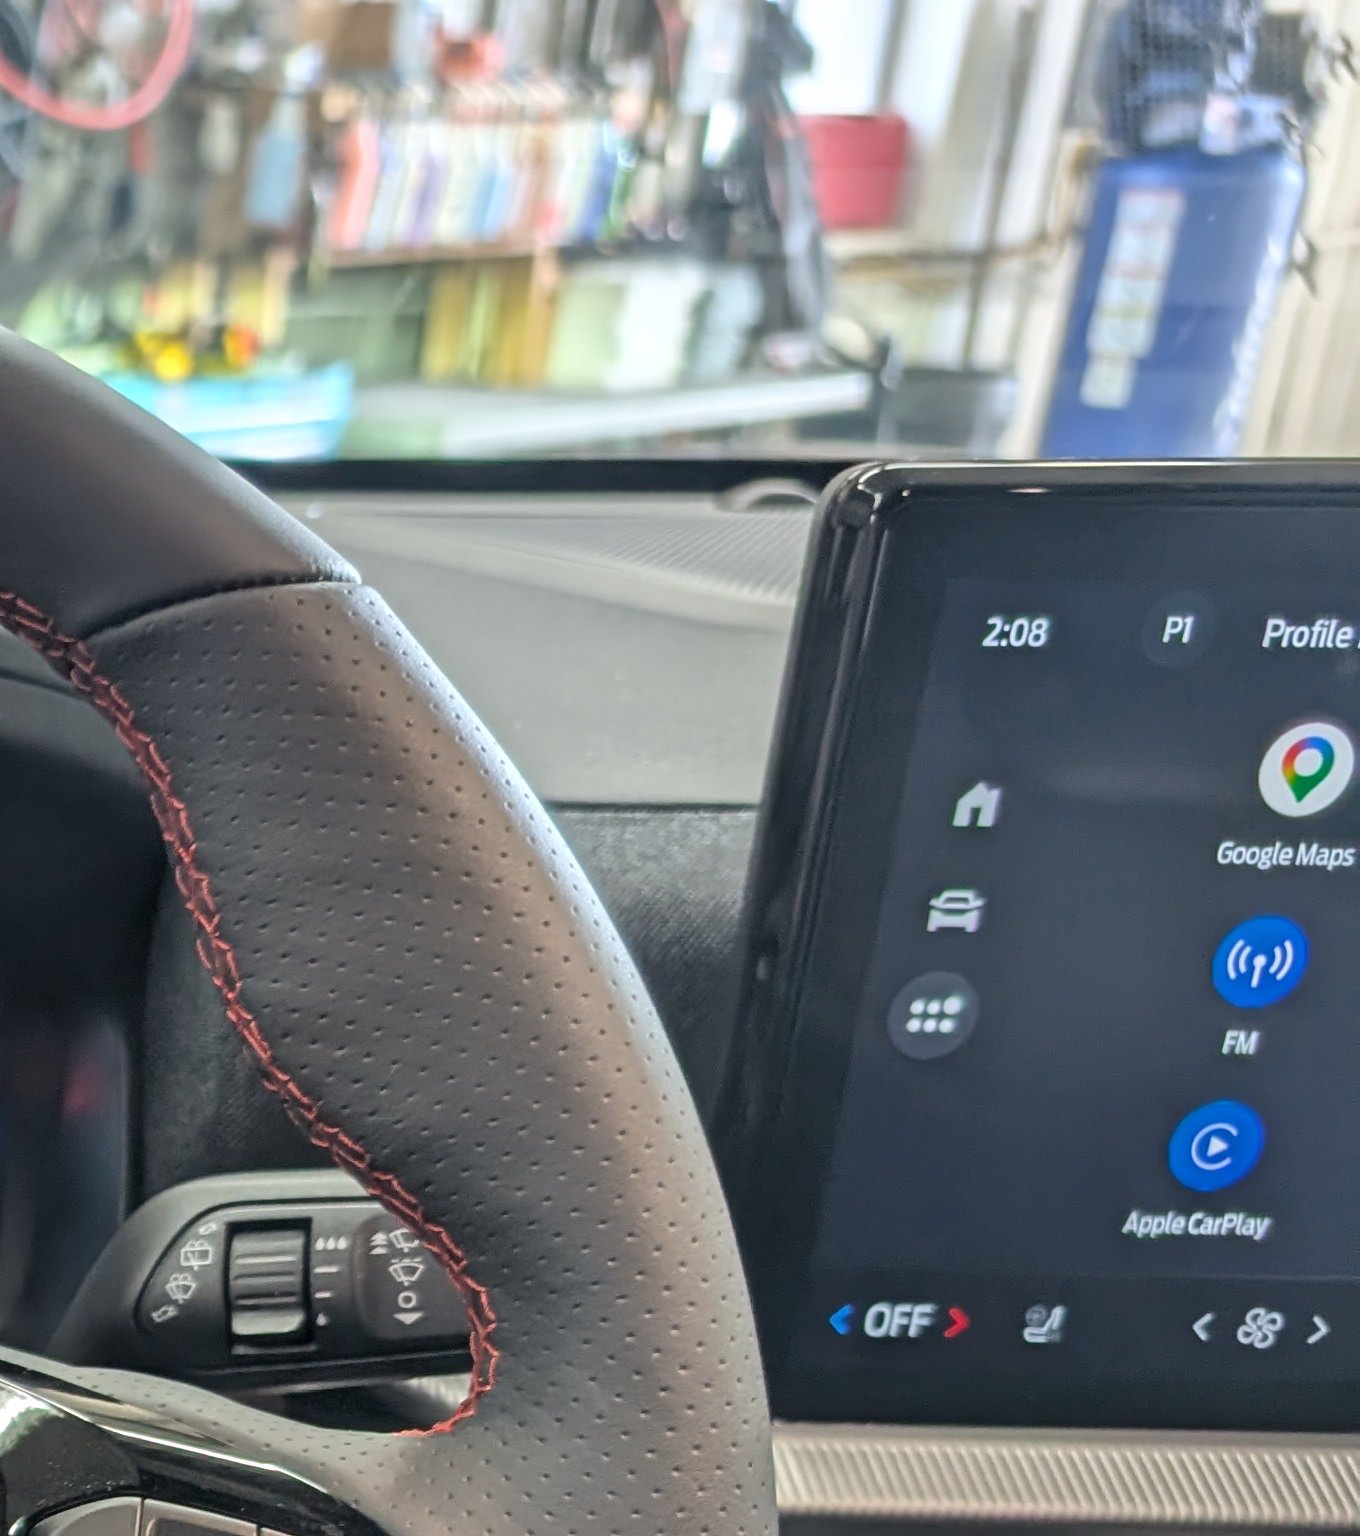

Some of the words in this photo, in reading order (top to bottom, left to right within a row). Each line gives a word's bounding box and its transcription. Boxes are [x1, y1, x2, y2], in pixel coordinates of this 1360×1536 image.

[982, 616, 1049, 649] 2:08
[1261, 617, 1355, 649] Profile
[1216, 841, 1293, 870] Google
[1294, 842, 1357, 871] Maps
[1221, 1030, 1262, 1056] FM
[1121, 1210, 1185, 1239] Apple
[1187, 1212, 1272, 1241] CarPlay
[863, 1303, 938, 1339] OFF
